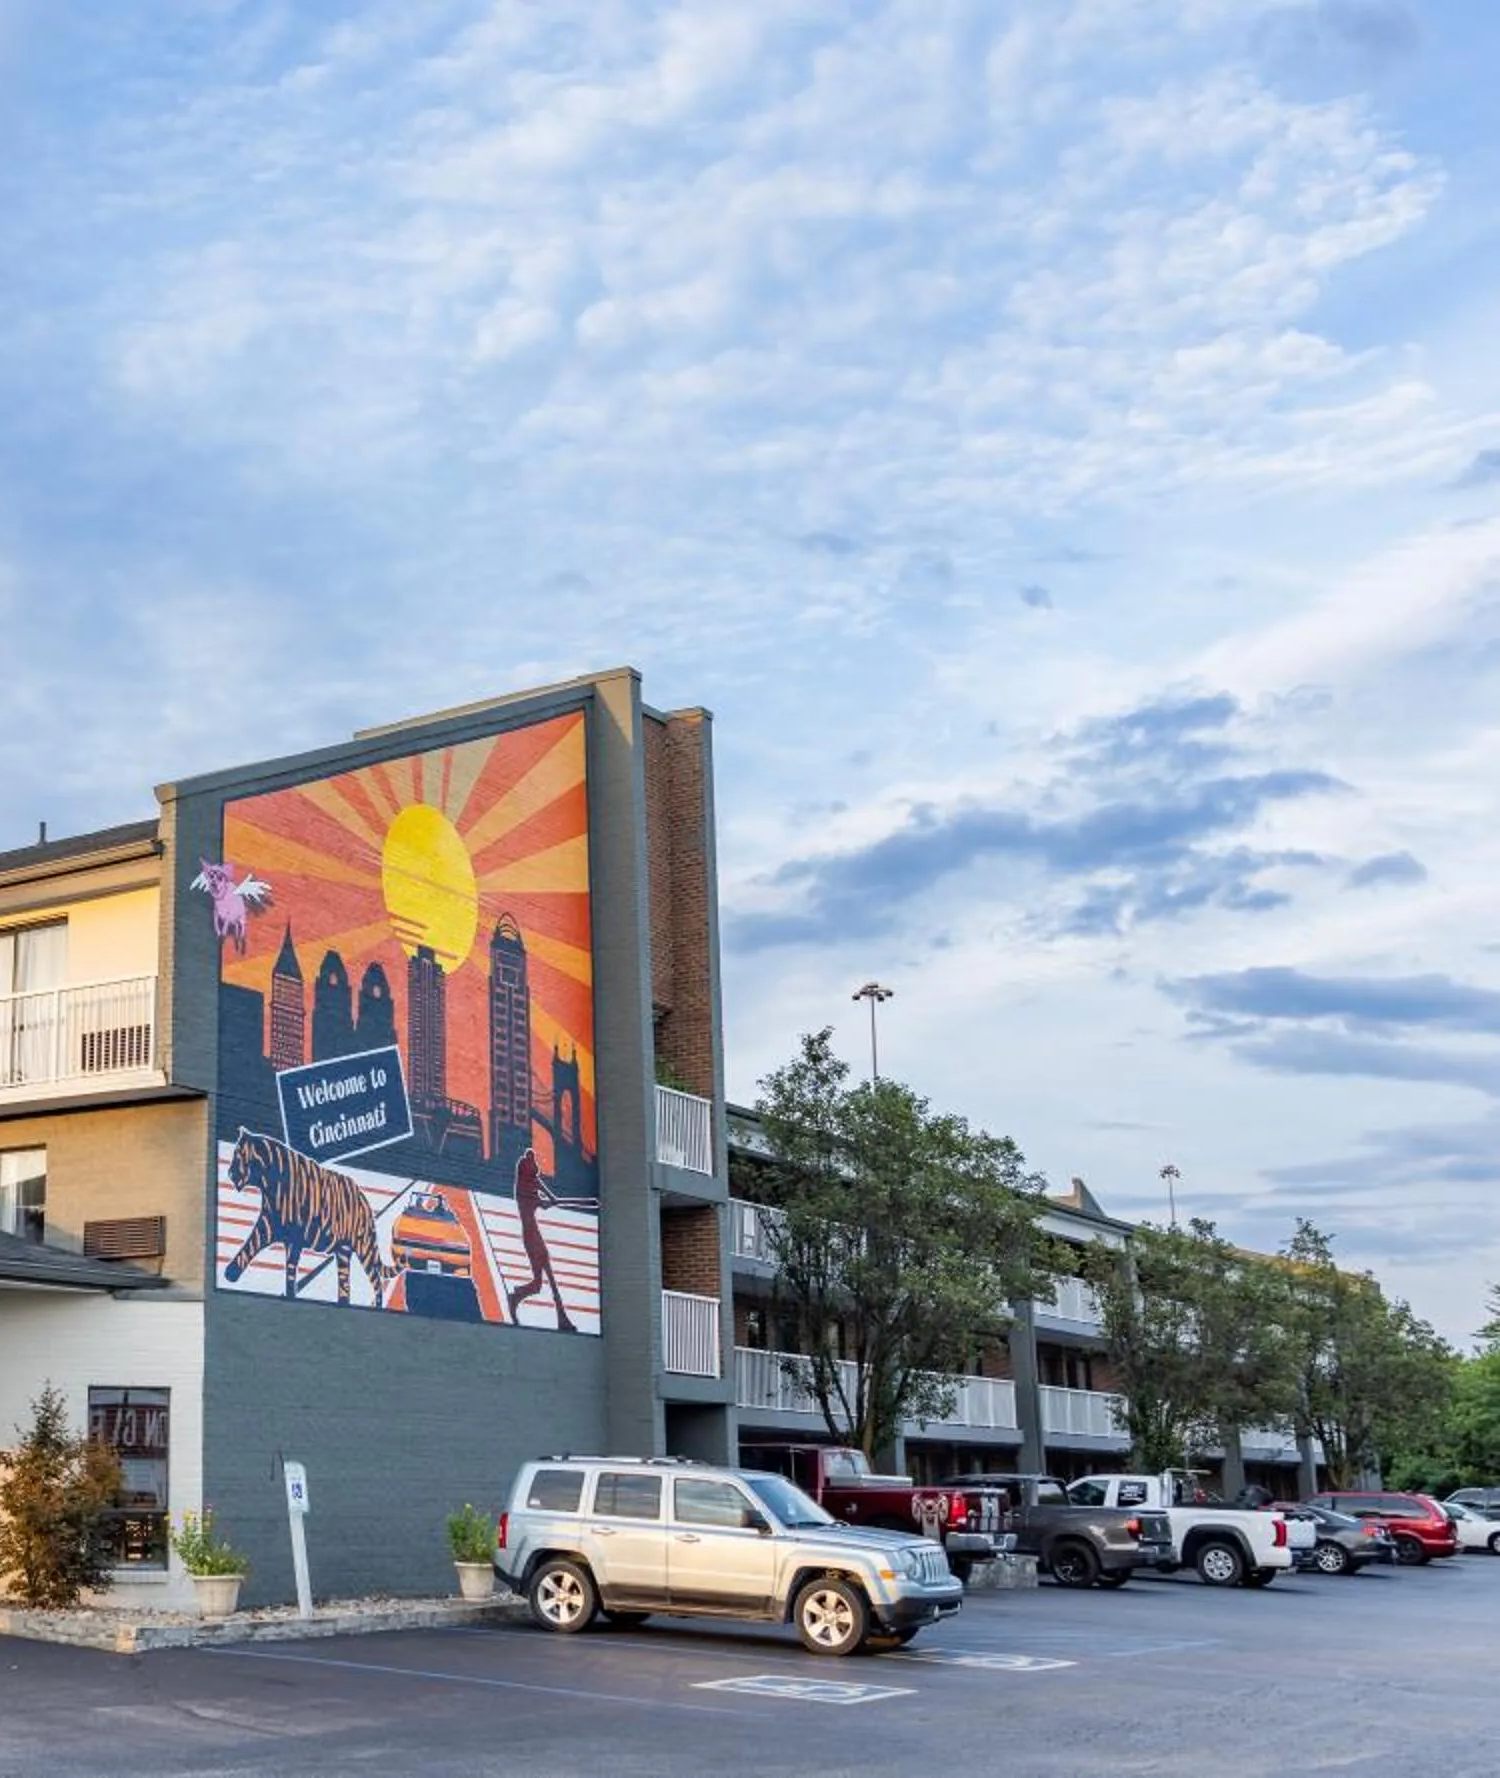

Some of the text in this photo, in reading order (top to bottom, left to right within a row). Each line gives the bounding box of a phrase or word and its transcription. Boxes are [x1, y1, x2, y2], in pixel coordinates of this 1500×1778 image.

[297, 1066, 387, 1109] Welcome to
[309, 1101, 387, 1148] Cincinnati
